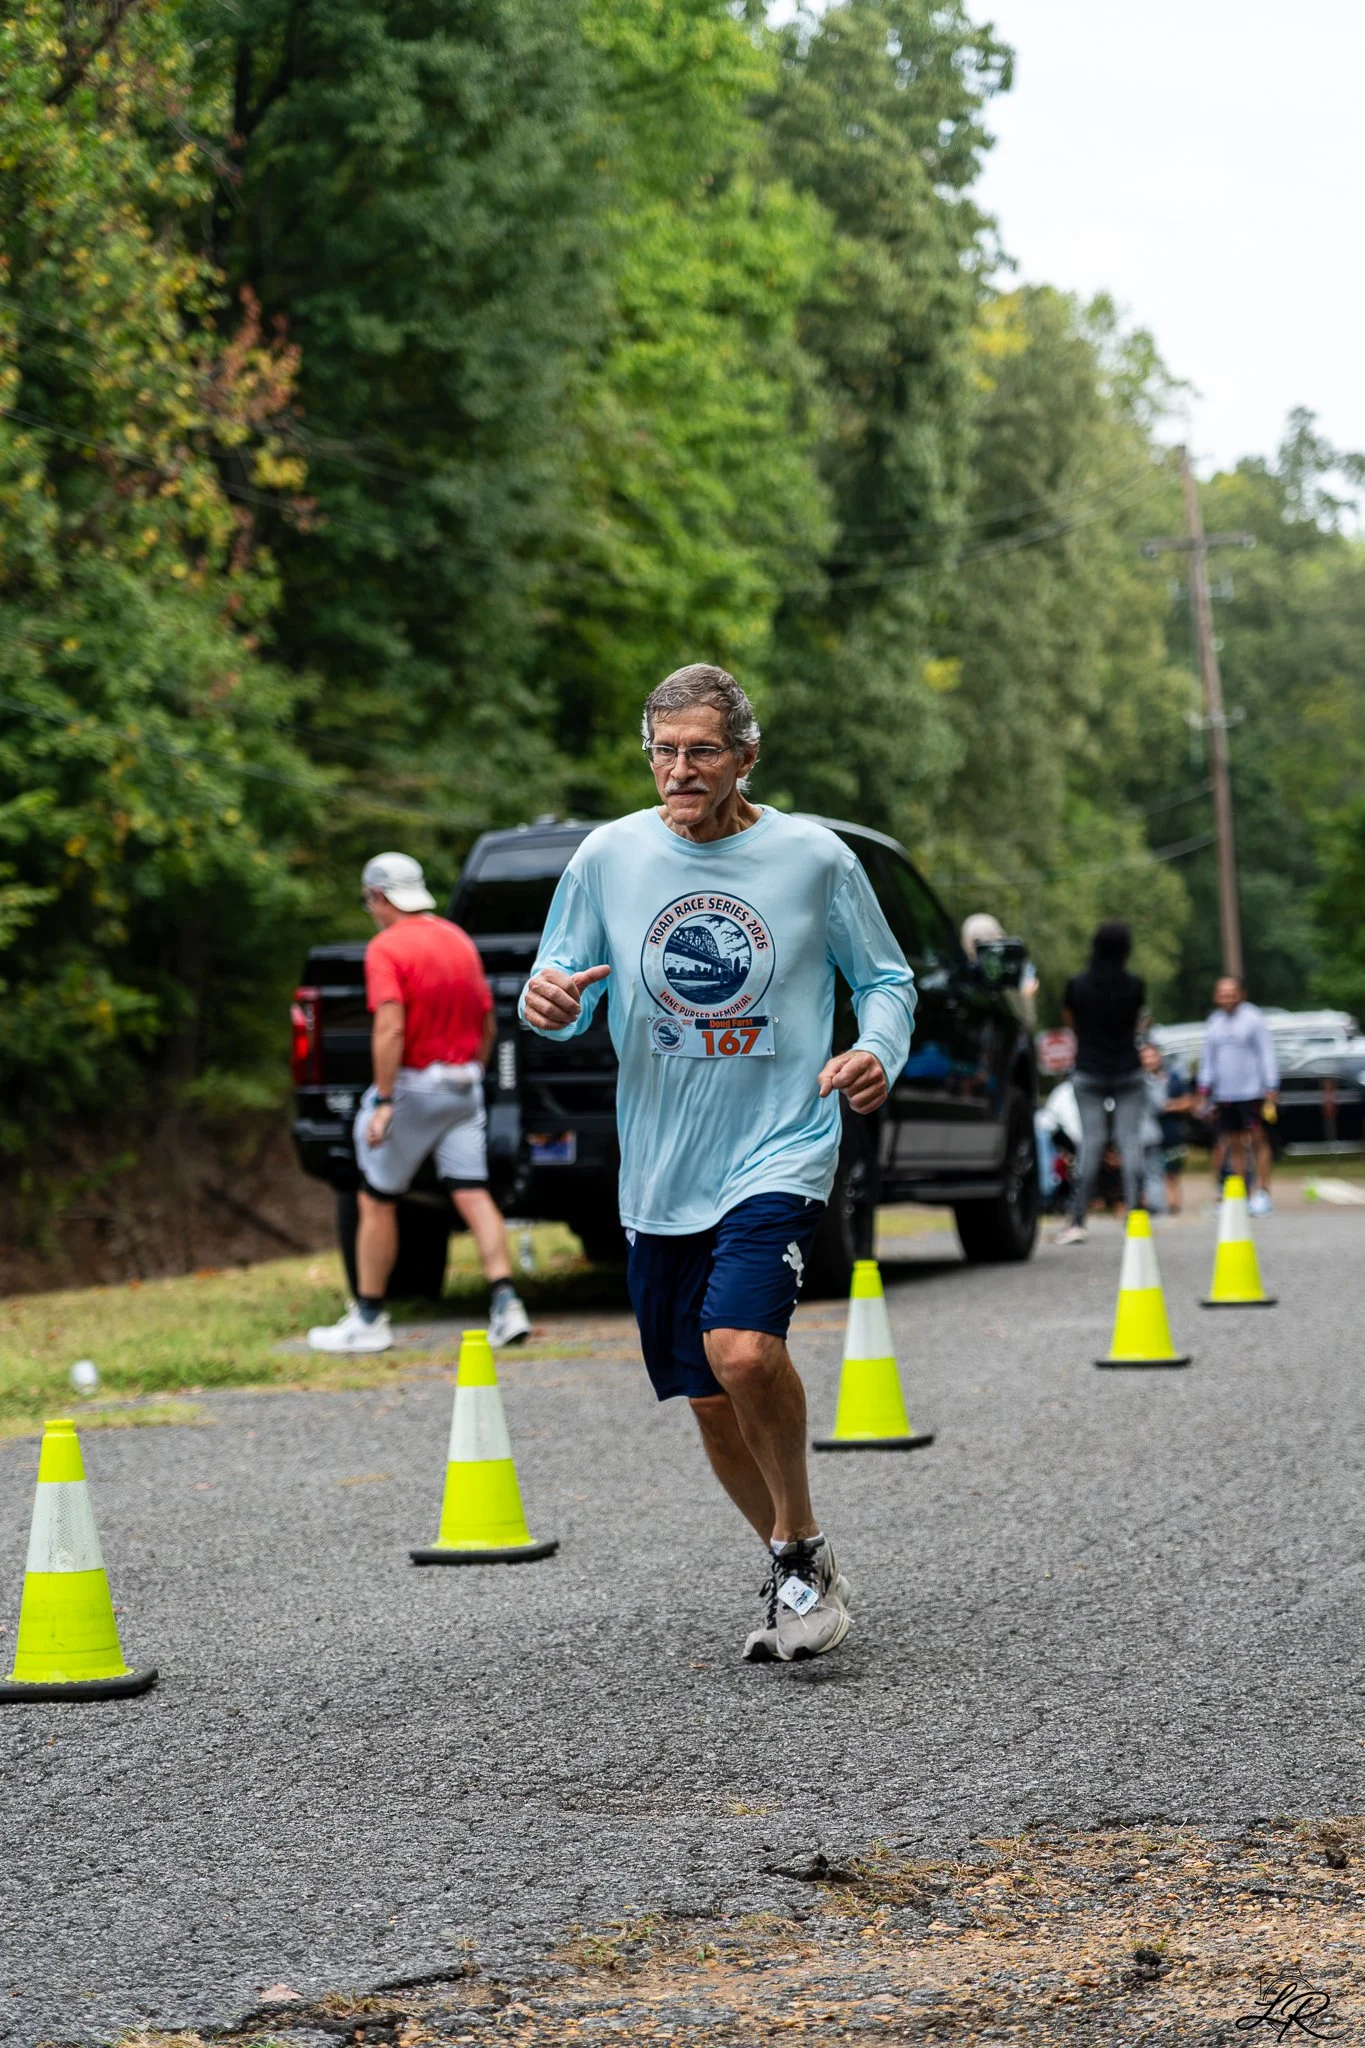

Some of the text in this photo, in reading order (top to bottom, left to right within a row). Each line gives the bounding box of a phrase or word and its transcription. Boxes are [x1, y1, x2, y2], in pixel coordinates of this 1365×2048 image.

[650, 898, 768, 950] ROAD RACE SERIES 2026
[659, 991, 679, 1010] LANE
[709, 1019, 731, 1029] Doug
[702, 1028, 761, 1056] 167
